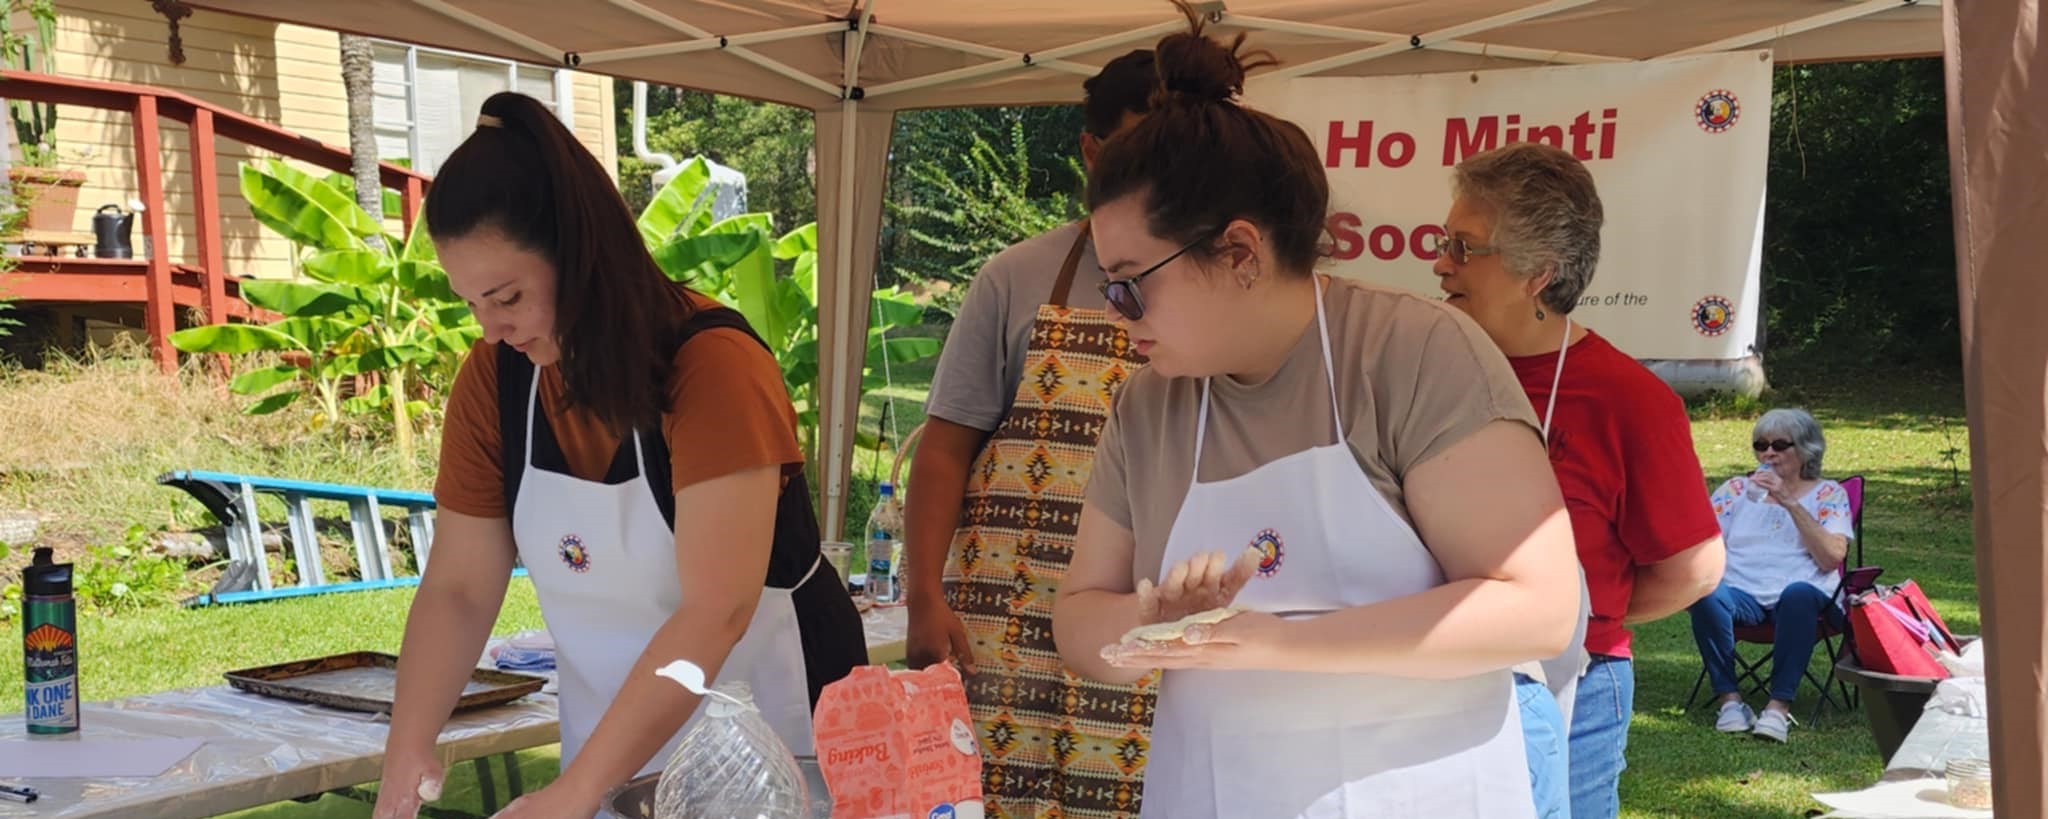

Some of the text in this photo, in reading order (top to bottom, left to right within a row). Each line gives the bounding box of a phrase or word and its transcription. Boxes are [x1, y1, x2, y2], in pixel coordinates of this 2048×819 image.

[1326, 108, 1618, 168] Ho Minti
[1604, 293, 1624, 307] of
[1624, 292, 1649, 306] the
[43, 681, 72, 704] ONE
[33, 703, 65, 719] DANE
[827, 743, 890, 765] Baking
